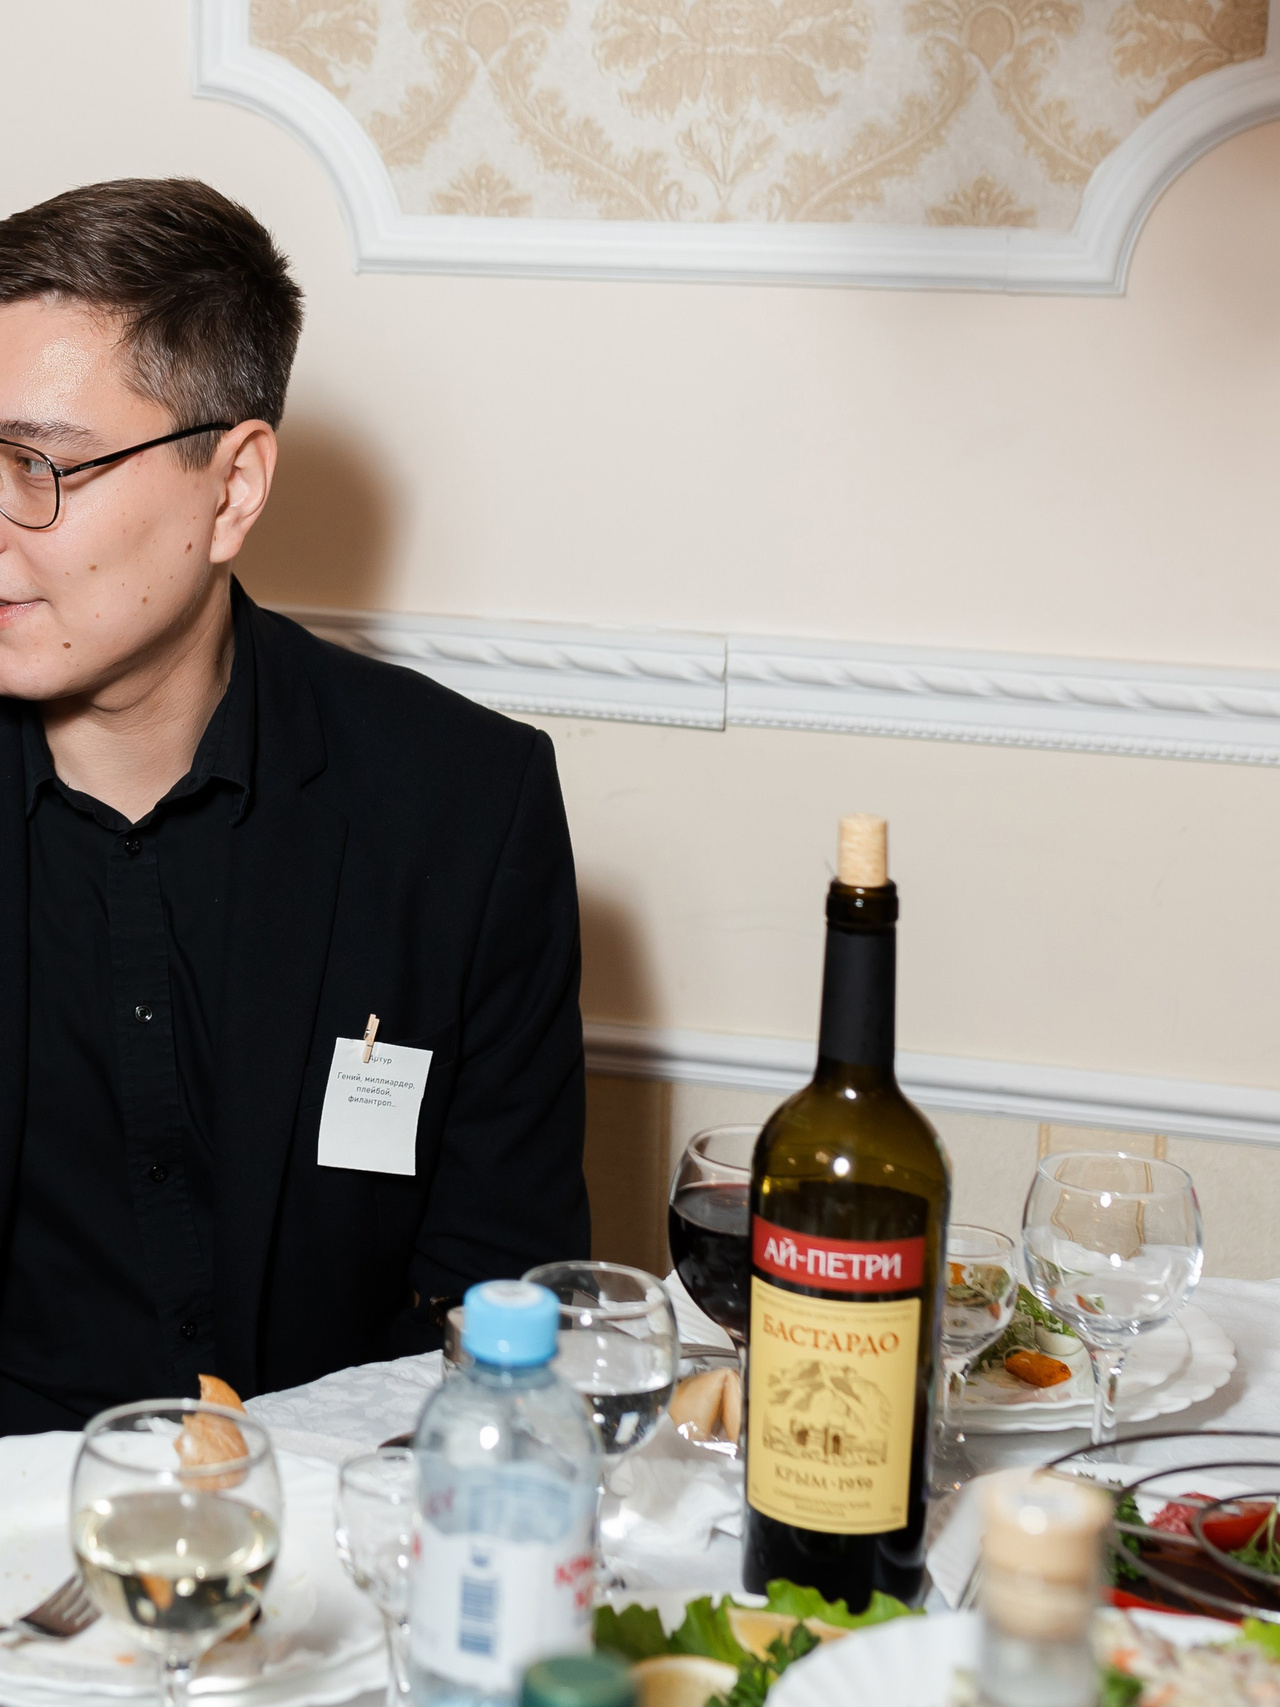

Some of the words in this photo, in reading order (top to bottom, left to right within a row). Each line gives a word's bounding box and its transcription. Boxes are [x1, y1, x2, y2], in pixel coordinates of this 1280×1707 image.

[337, 1071, 362, 1082] Гений,
[365, 1076, 415, 1089] миллиардер,
[356, 1086, 392, 1097] плейбой,
[763, 1236, 902, 1281] АЙ-ПЕТРИ
[762, 1312, 900, 1358] БАСТАРДО
